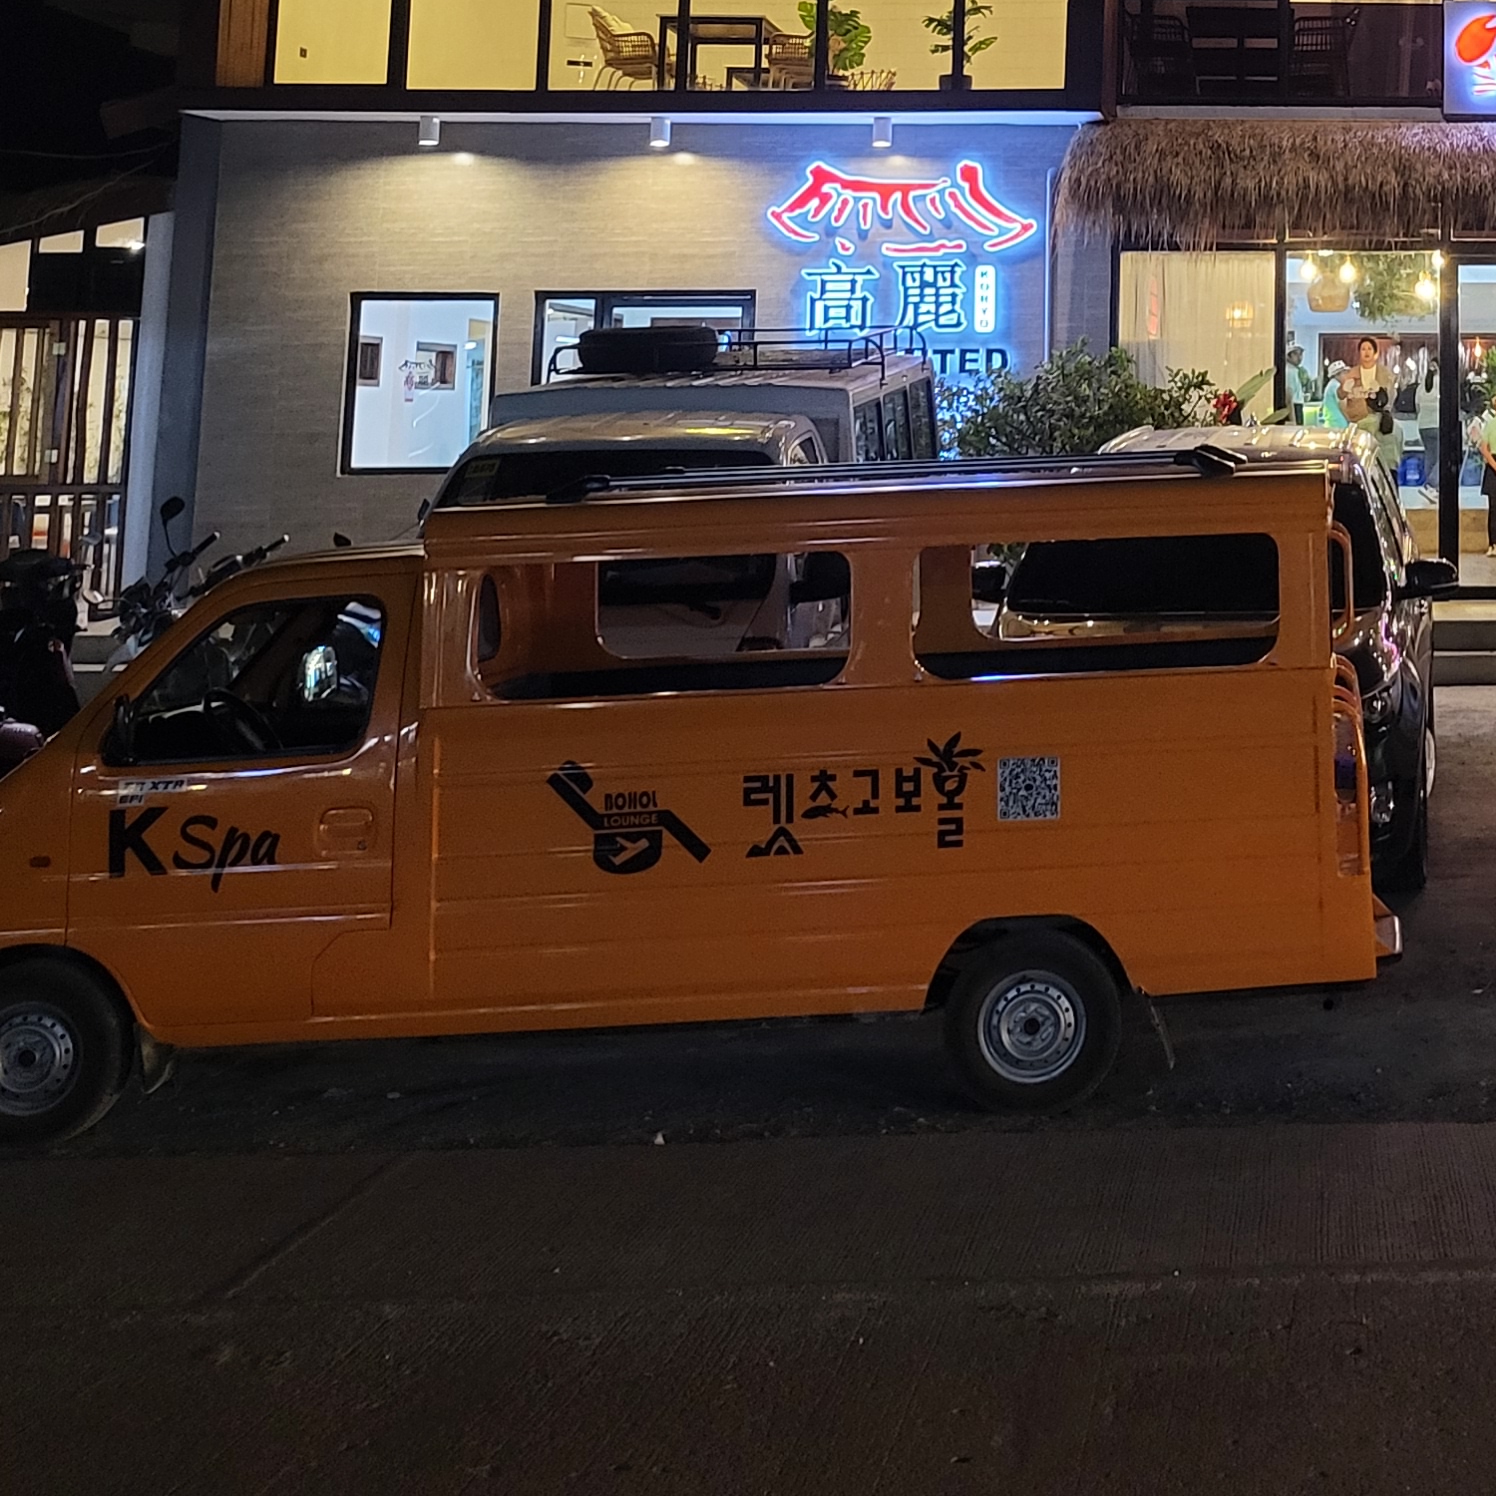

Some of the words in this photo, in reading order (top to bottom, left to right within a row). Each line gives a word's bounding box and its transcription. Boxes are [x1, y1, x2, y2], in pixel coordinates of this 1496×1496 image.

[803, 260, 967, 334] 高麗
[603, 813, 659, 827] LOUNGE
[604, 791, 658, 811] BOHOL
[109, 807, 169, 879] K
[172, 814, 281, 893] Spa
